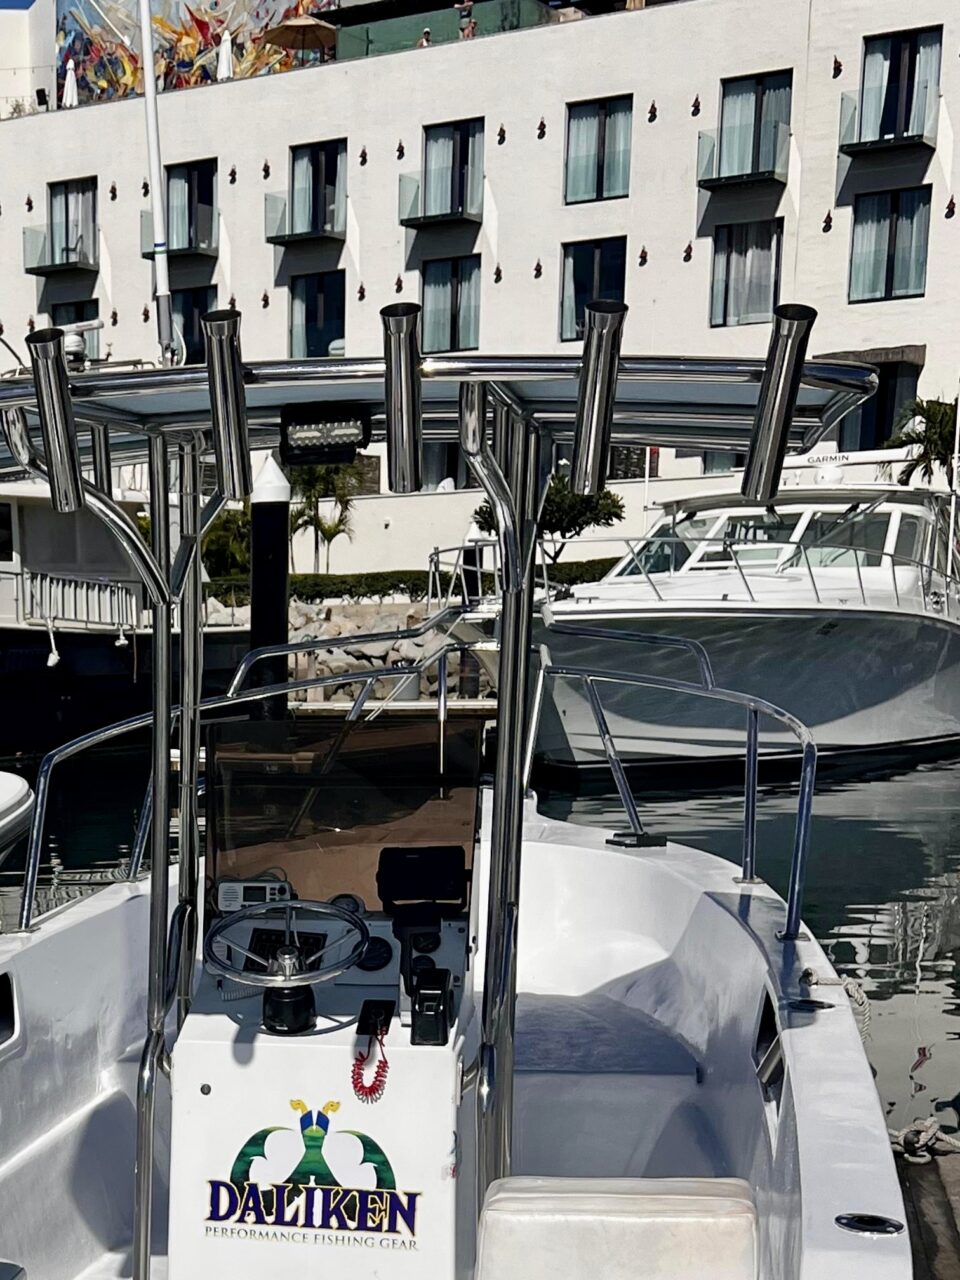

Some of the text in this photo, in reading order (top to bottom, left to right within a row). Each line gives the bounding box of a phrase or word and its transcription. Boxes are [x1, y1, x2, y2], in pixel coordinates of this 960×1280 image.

[807, 454, 849, 465] GARMIN
[204, 1179, 423, 1237] DALIKEN
[204, 1226, 418, 1250] PERFORMANCE FISHING GEAR
